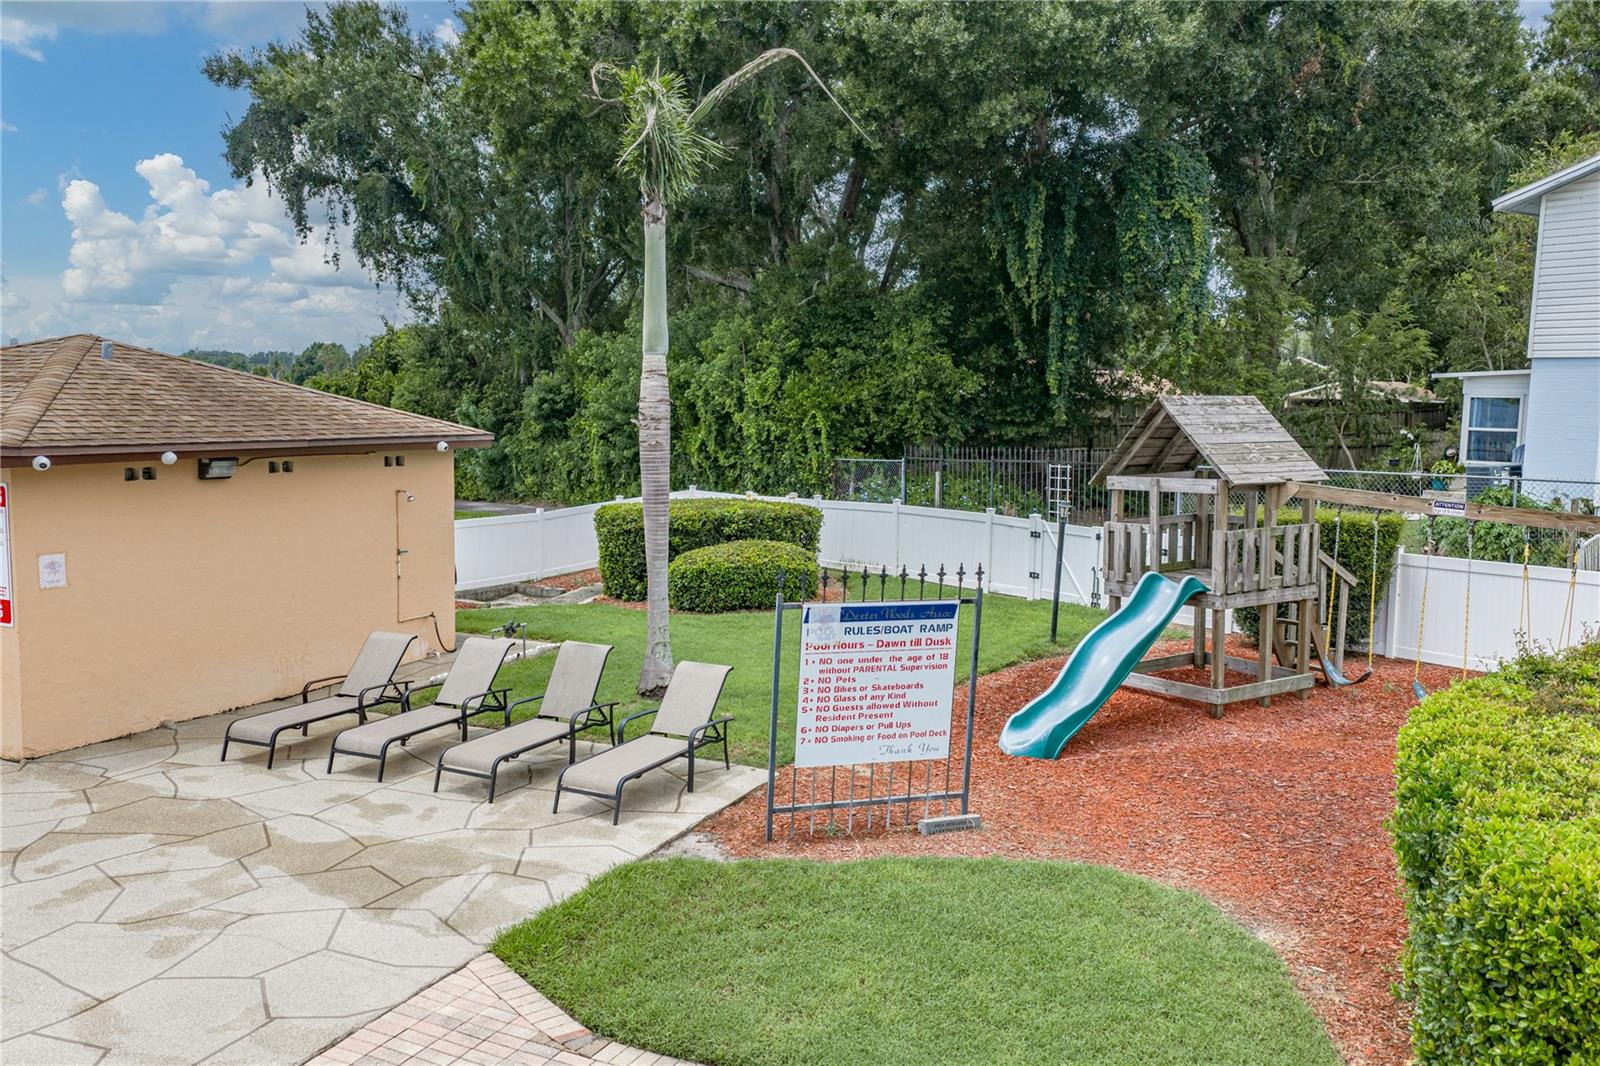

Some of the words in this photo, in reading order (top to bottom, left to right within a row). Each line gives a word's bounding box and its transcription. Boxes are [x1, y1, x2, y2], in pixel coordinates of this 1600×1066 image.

[1435, 502, 1464, 510] ATTENTION
[842, 608, 878, 620] Dexter
[880, 607, 914, 619] Woods
[844, 624, 914, 636] RULES/BOAT
[920, 623, 954, 633] RAMP
[832, 641, 865, 650] Hours
[876, 639, 906, 648] Dawn
[910, 638, 922, 647] till
[925, 637, 951, 646] Dusk
[853, 664, 897, 673] PARENTAL
[900, 663, 948, 672] Supervision
[872, 682, 924, 691] Skateboards
[888, 691, 906, 699] Kind
[866, 702, 901, 710] allowed
[815, 714, 856, 722] Resident
[859, 712, 893, 720] Present
[832, 725, 864, 733] Diapers
[896, 721, 911, 729] Ups
[831, 735, 865, 743] Smoking
[877, 732, 896, 740] Food
[879, 743, 913, 755] Thank
[918, 743, 939, 755] You
